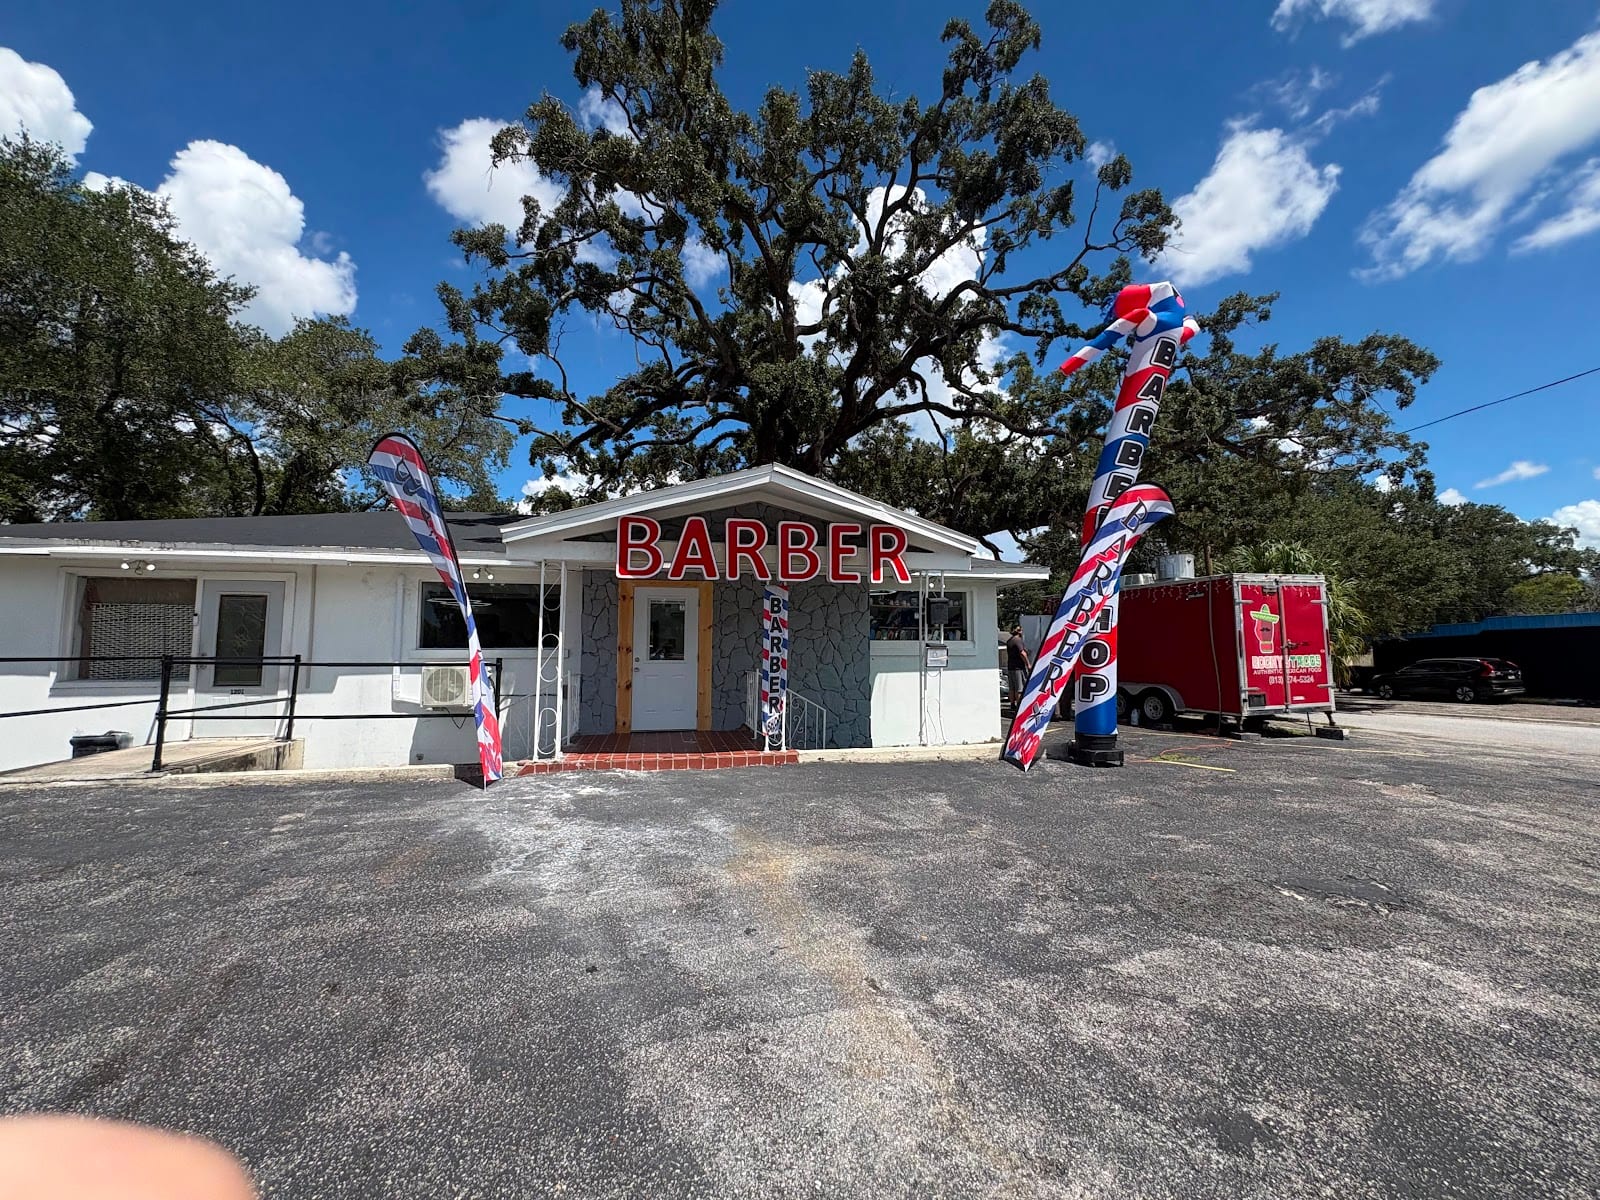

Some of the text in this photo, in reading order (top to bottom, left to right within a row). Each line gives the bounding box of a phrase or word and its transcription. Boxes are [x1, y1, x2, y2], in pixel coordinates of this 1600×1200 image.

[1096, 336, 1177, 530] BARBE
[616, 515, 912, 584] BARBER
[1038, 497, 1148, 698] BARBER
[768, 595, 784, 715] BARBER
[1079, 600, 1114, 703] HOP
